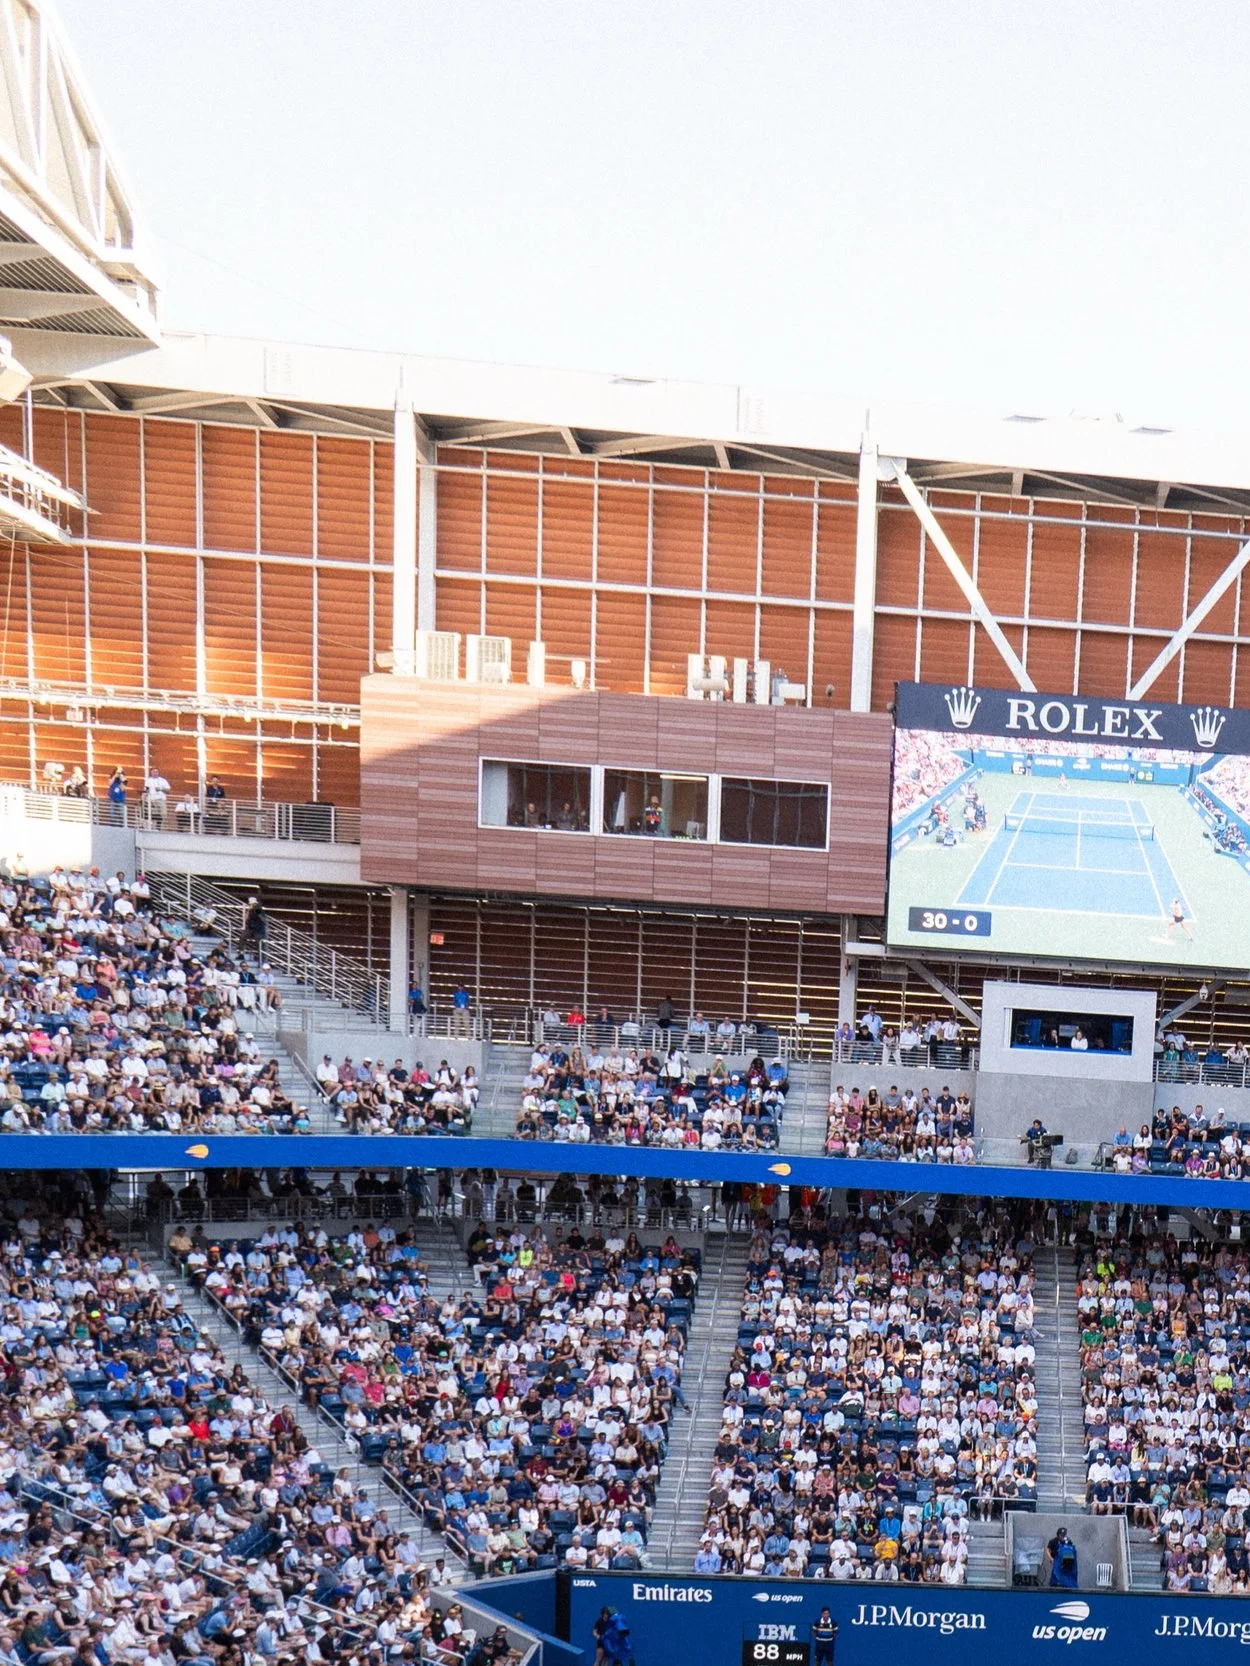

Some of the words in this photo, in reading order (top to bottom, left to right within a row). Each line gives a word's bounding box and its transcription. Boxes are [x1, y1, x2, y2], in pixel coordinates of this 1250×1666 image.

[1005, 698, 1164, 742] ROLEX
[921, 912, 948, 930] 30
[964, 915, 979, 932] 0
[572, 1579, 597, 1588] USTA
[632, 1583, 713, 1603] Emirates
[771, 1593, 782, 1602] us
[782, 1594, 803, 1604] open
[851, 1604, 987, 1635] J.P.Morgan
[758, 1624, 797, 1641] IBM
[1032, 1625, 1056, 1640] us
[1057, 1626, 1107, 1644] open
[753, 1643, 780, 1660] 88
[785, 1653, 803, 1661] MPH
